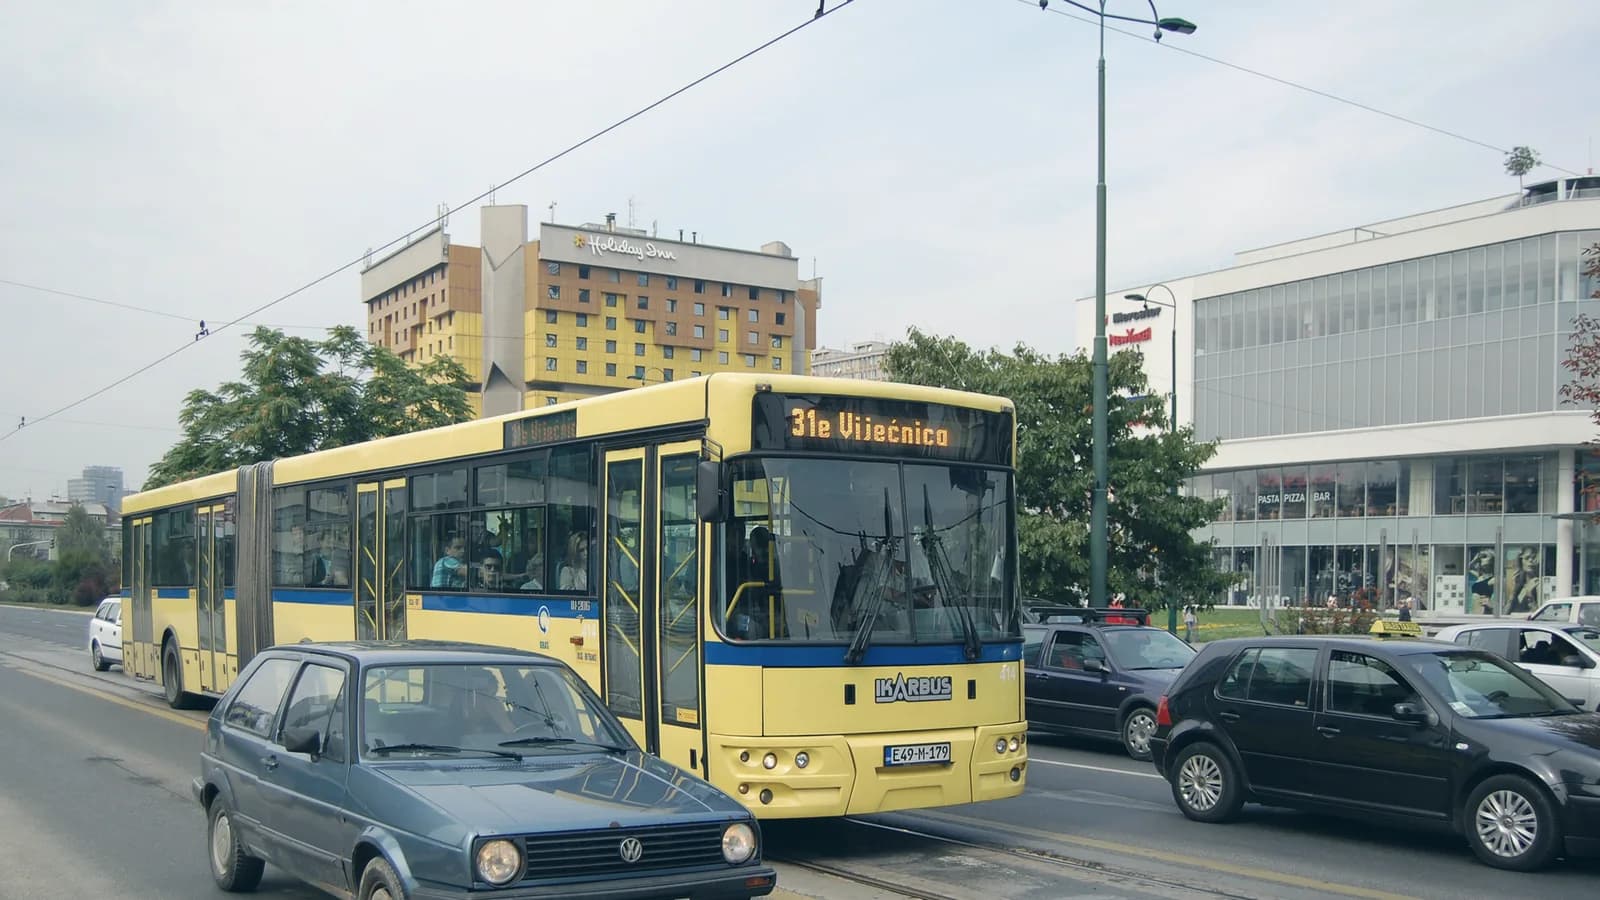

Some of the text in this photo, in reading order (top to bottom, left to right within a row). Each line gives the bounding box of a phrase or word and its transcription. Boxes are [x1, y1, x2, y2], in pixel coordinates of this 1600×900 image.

[588, 234, 677, 260] Holiday Inn
[791, 408, 949, 447] 31e Vijećnica
[1257, 491, 1331, 504] PASTA PIZZA BAR
[875, 672, 952, 703] IKARBUS
[892, 745, 949, 763] E49-M-179
